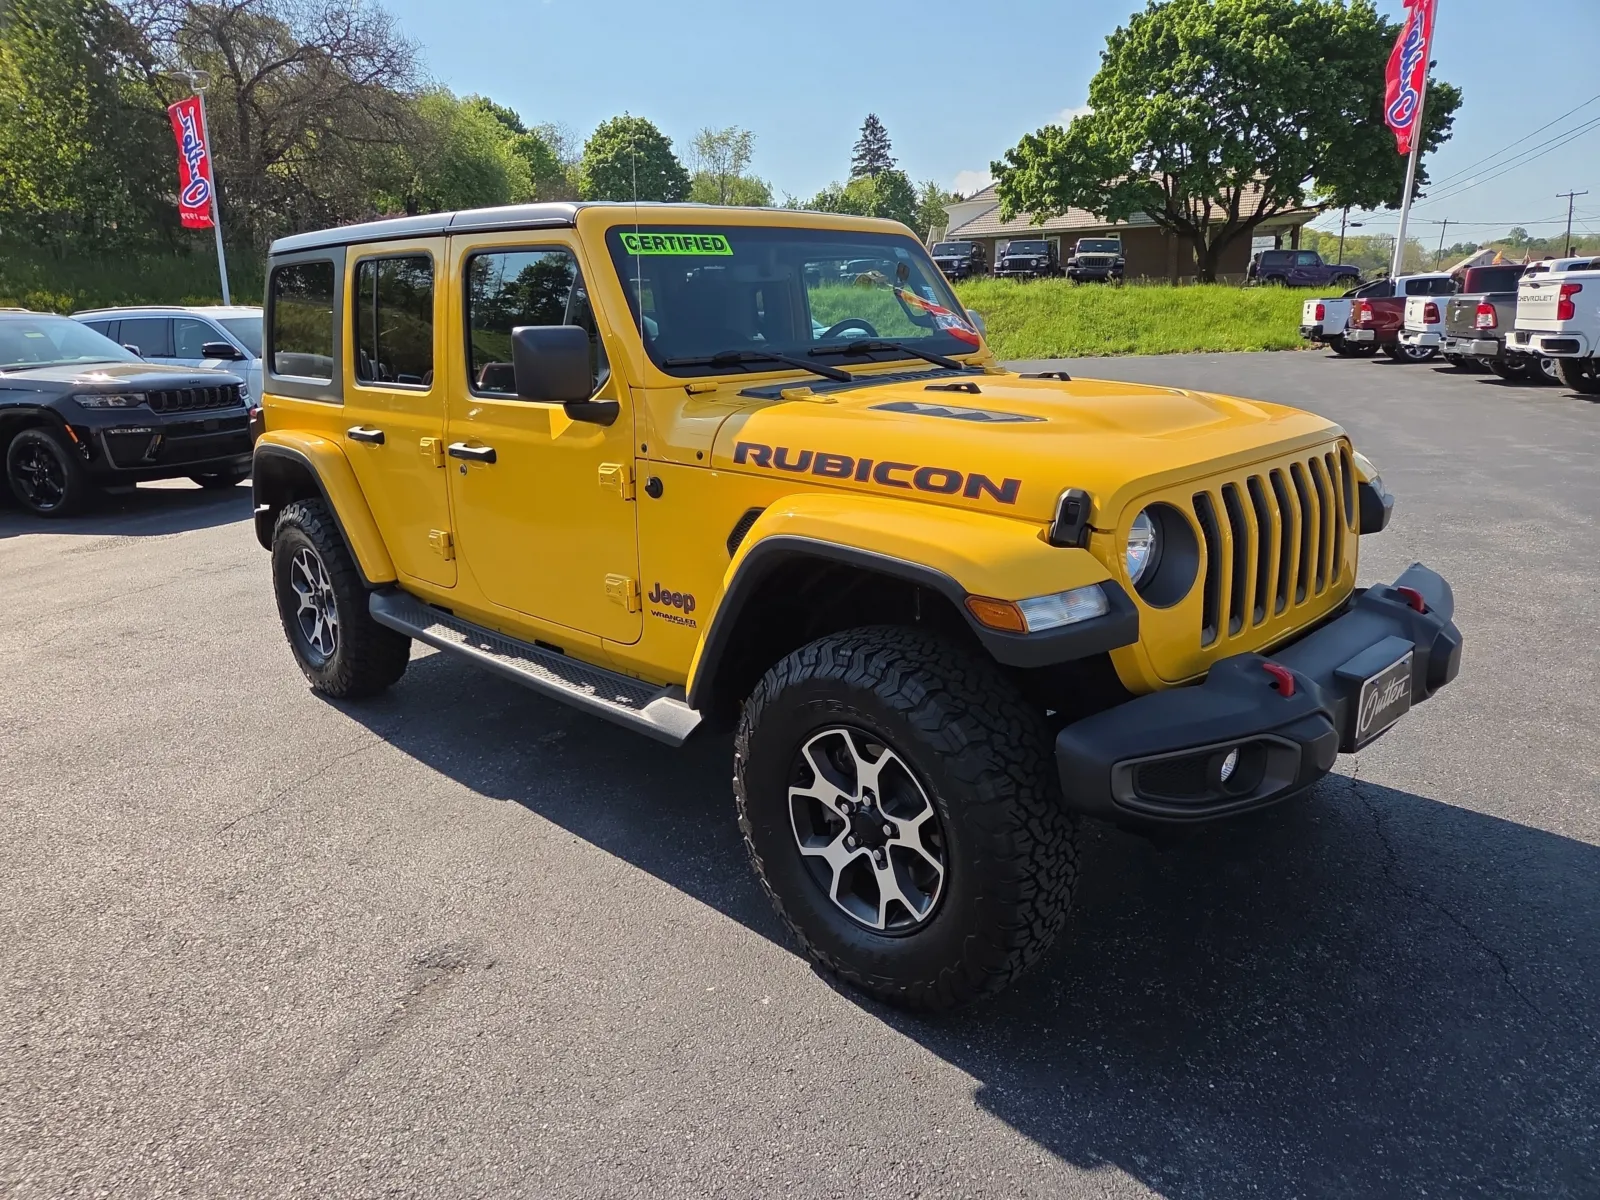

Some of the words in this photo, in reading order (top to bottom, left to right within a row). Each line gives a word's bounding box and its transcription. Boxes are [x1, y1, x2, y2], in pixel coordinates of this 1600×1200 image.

[624, 235, 727, 252] CERTIFIED
[733, 441, 1022, 505] RUBICON
[648, 582, 696, 614] Jeep
[651, 609, 697, 625] WRANGLER
[1361, 674, 1410, 732] Outten
